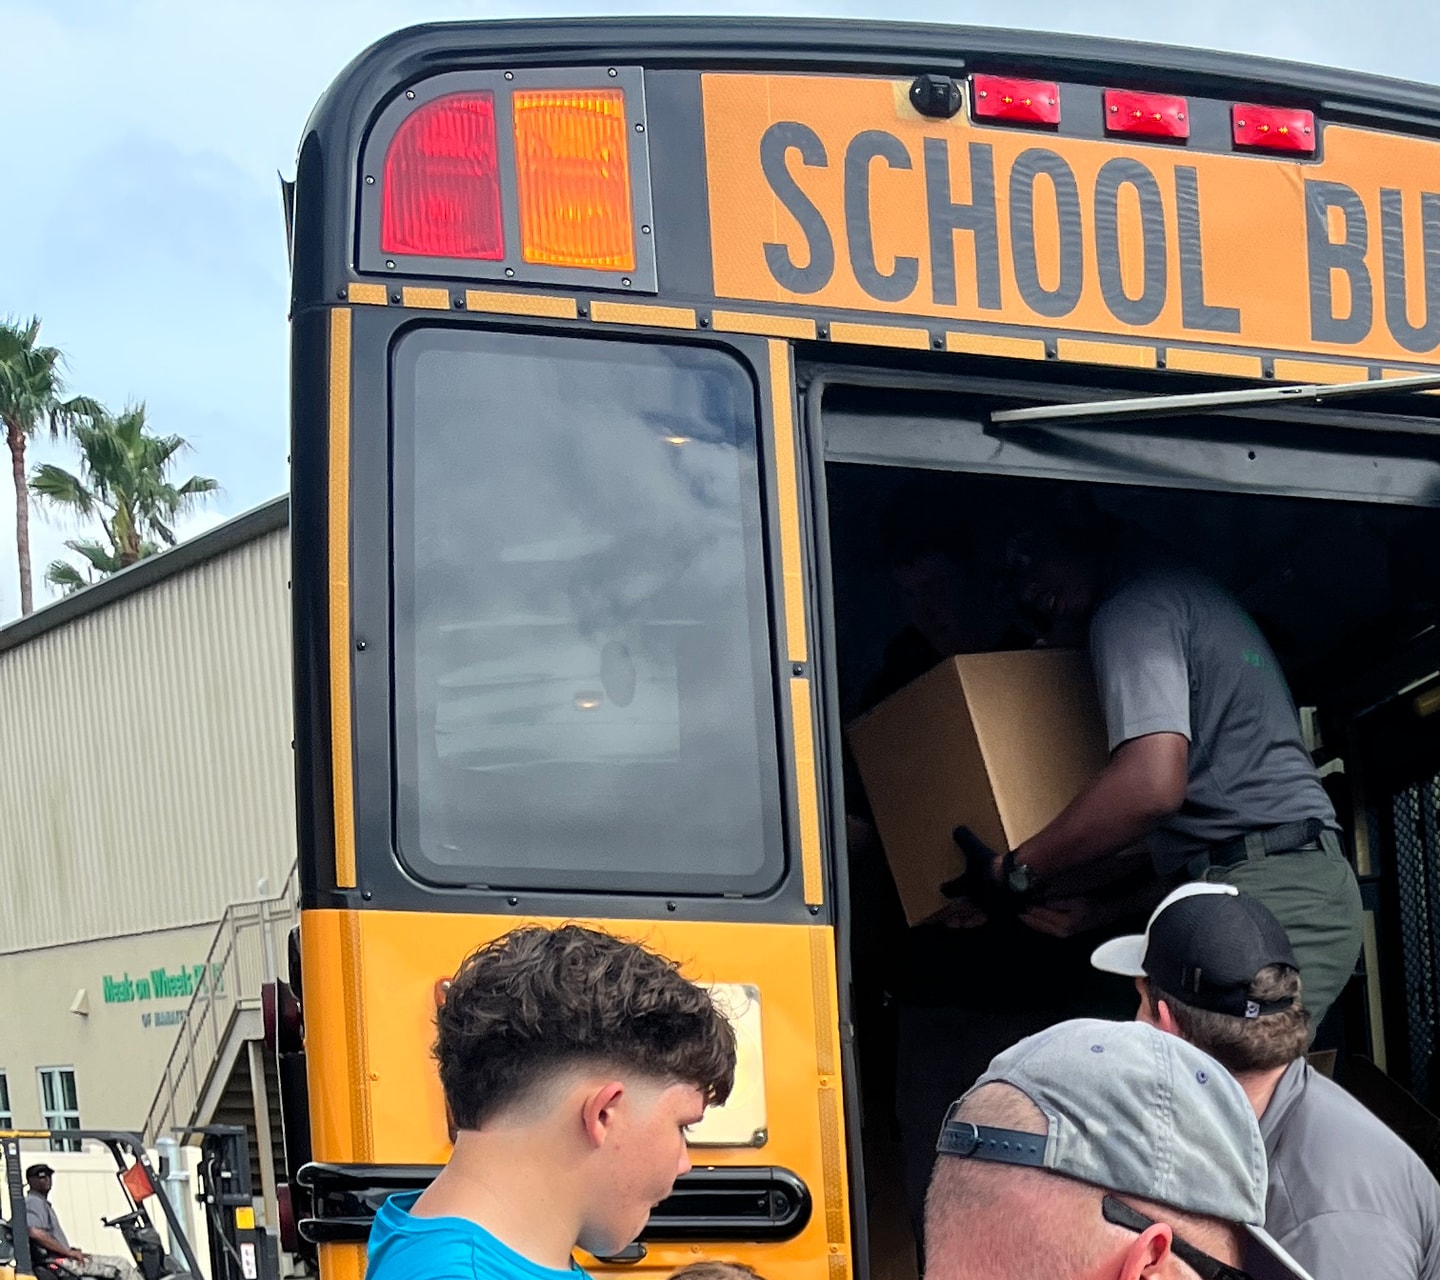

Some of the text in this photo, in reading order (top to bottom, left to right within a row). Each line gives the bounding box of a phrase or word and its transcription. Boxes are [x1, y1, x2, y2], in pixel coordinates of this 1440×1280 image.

[760, 120, 1241, 335] SCHOOL
[103, 973, 135, 1003] Meals
[136, 979, 150, 999] on
[150, 965, 193, 998] Wheels
